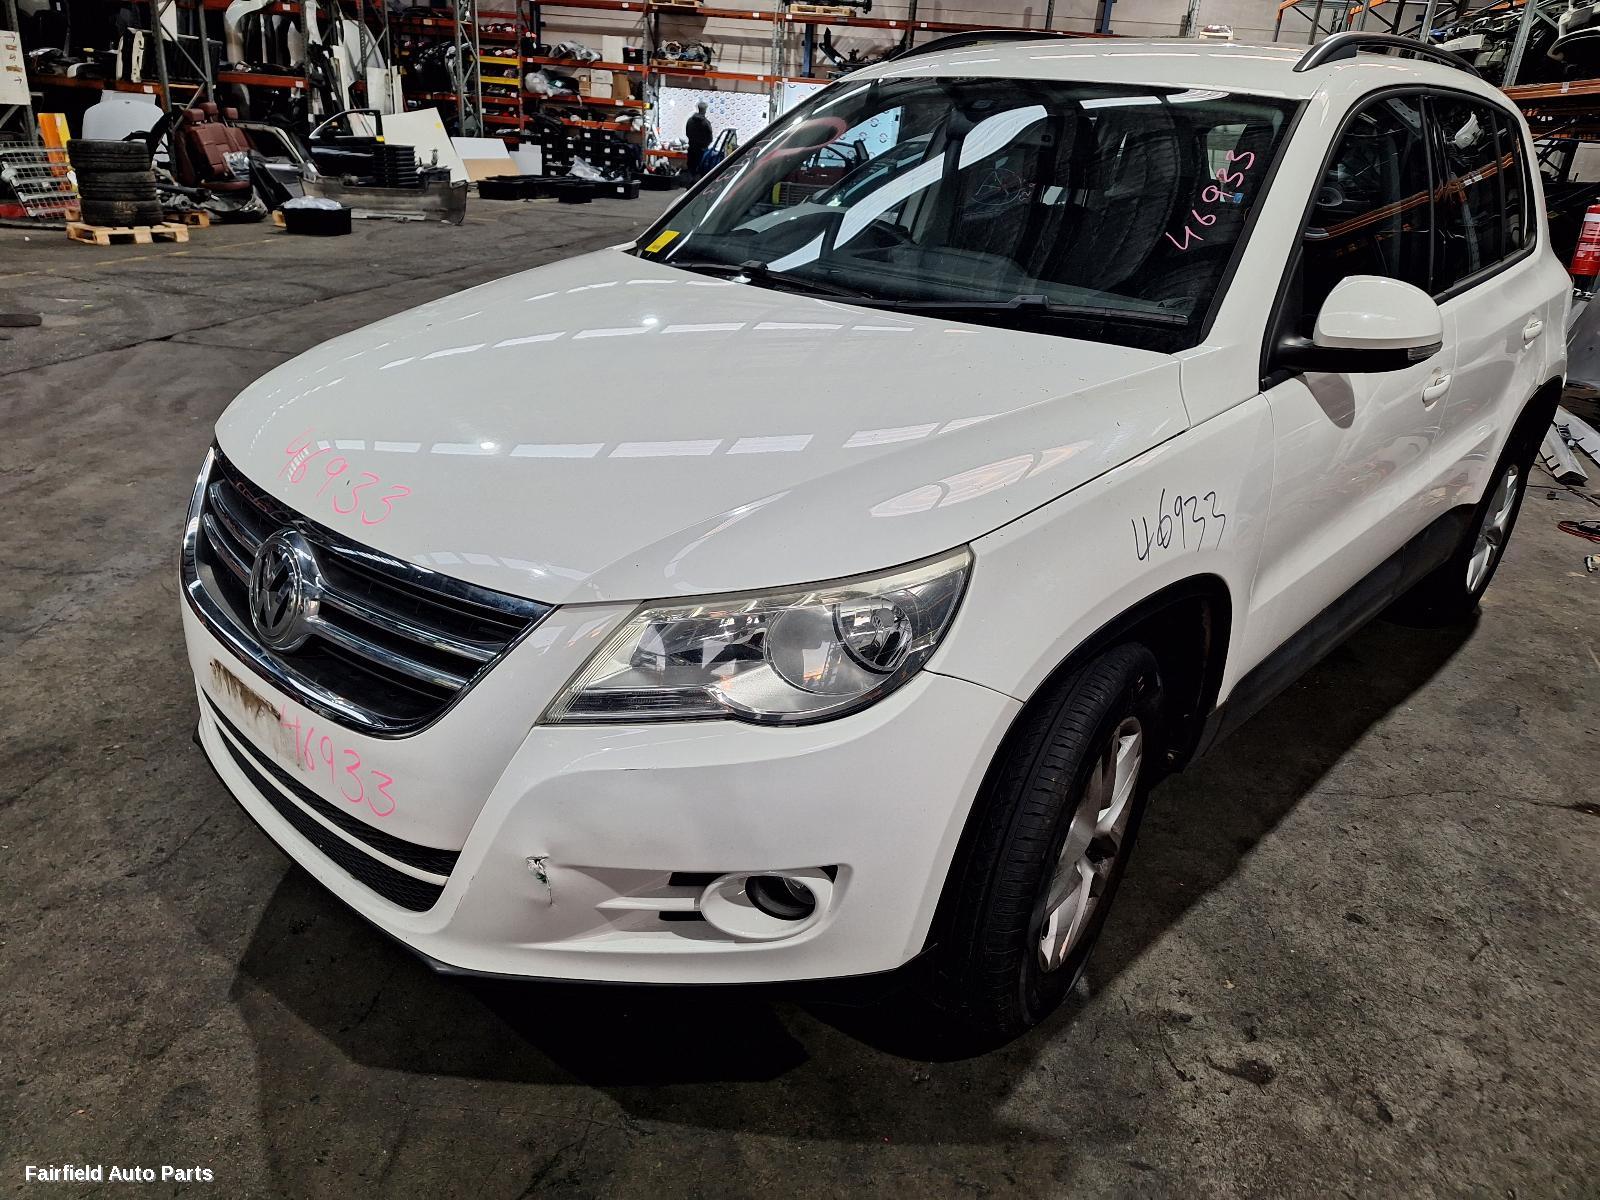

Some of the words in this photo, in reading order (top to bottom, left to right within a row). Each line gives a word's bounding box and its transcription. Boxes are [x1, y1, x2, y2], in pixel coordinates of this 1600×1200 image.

[1165, 150, 1255, 250] 46933
[1131, 488, 1226, 562] 46933
[280, 703, 398, 818] 46933
